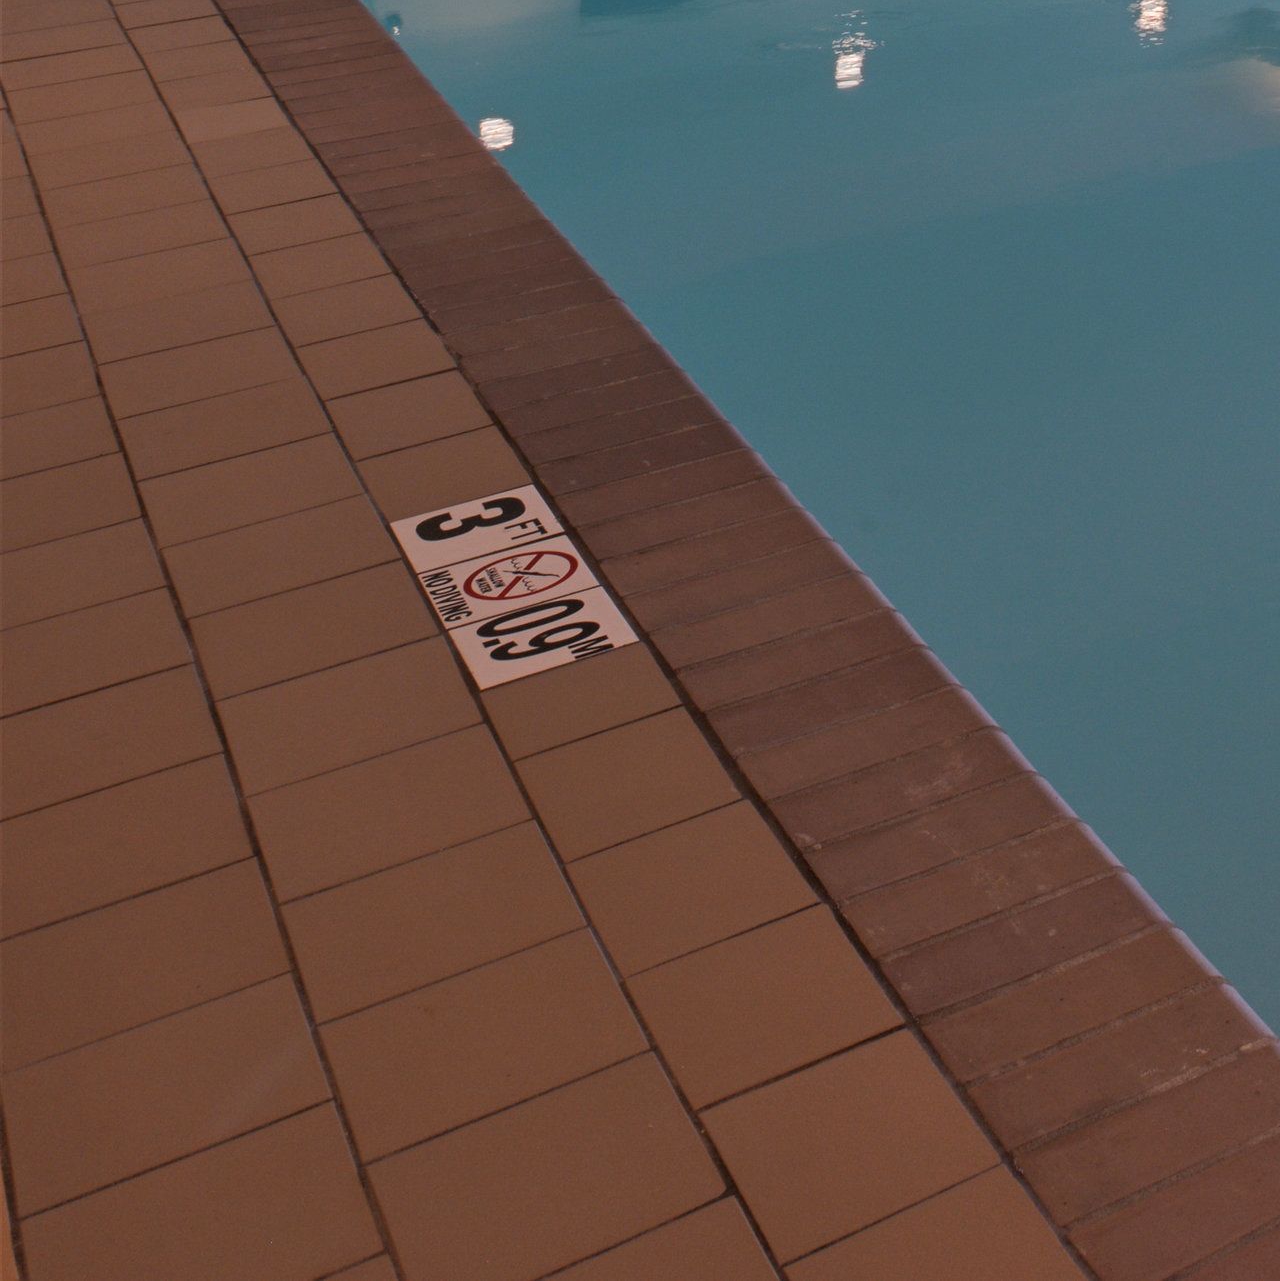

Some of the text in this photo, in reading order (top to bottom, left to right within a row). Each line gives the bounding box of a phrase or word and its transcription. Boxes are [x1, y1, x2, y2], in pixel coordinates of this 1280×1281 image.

[415, 496, 548, 541] 3 FT
[475, 577, 493, 594] WATER
[485, 567, 506, 588] SHALLOW
[421, 570, 473, 622] NO DIVING
